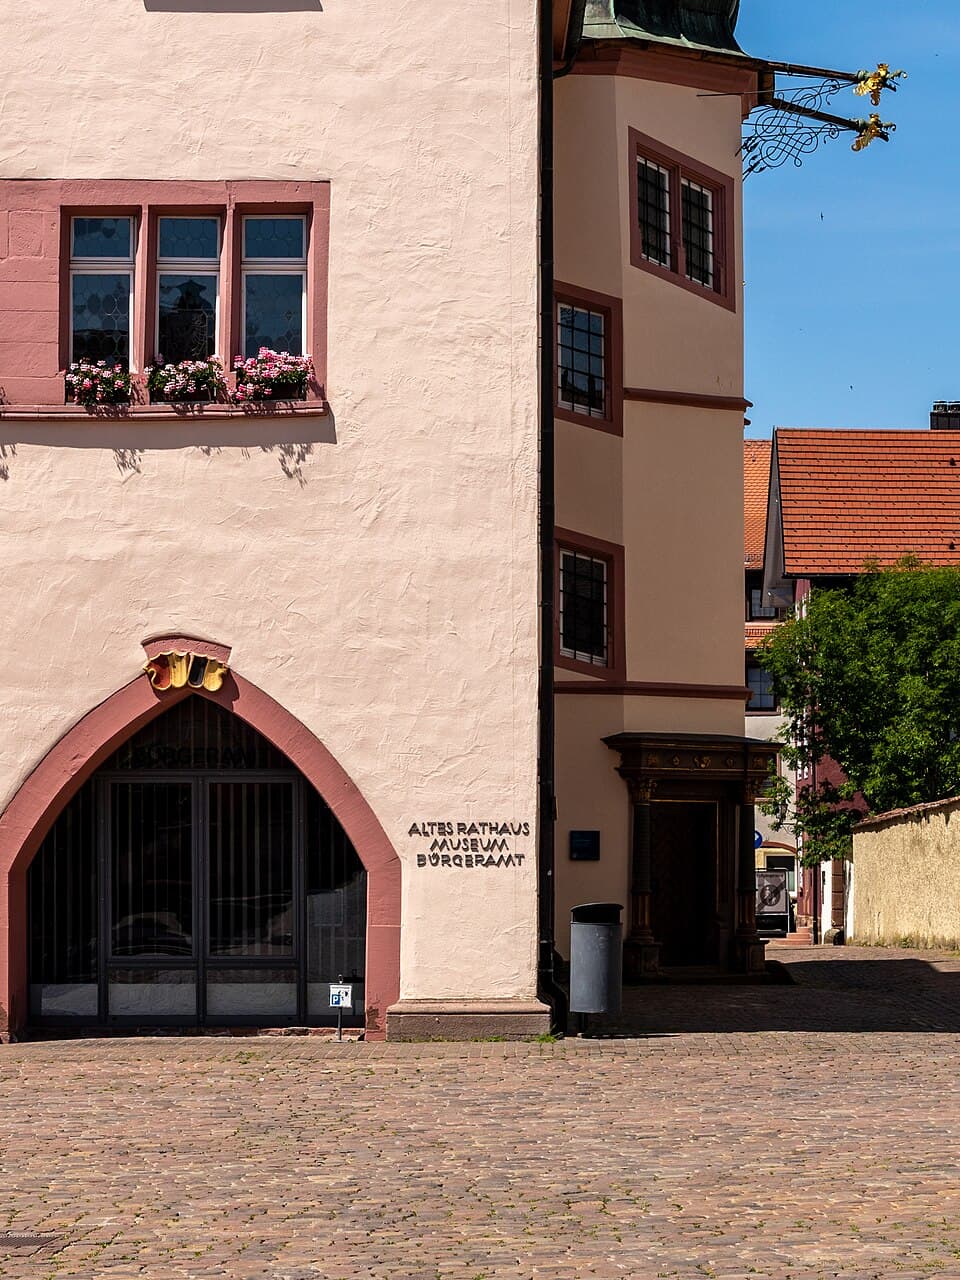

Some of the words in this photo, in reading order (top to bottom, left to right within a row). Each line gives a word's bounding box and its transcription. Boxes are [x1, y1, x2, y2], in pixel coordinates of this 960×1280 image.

[408, 822, 454, 837] ALTES
[457, 822, 530, 837] RATHAUS
[430, 838, 509, 852] MUSEUM
[416, 852, 525, 868] BÜRGERAMT
